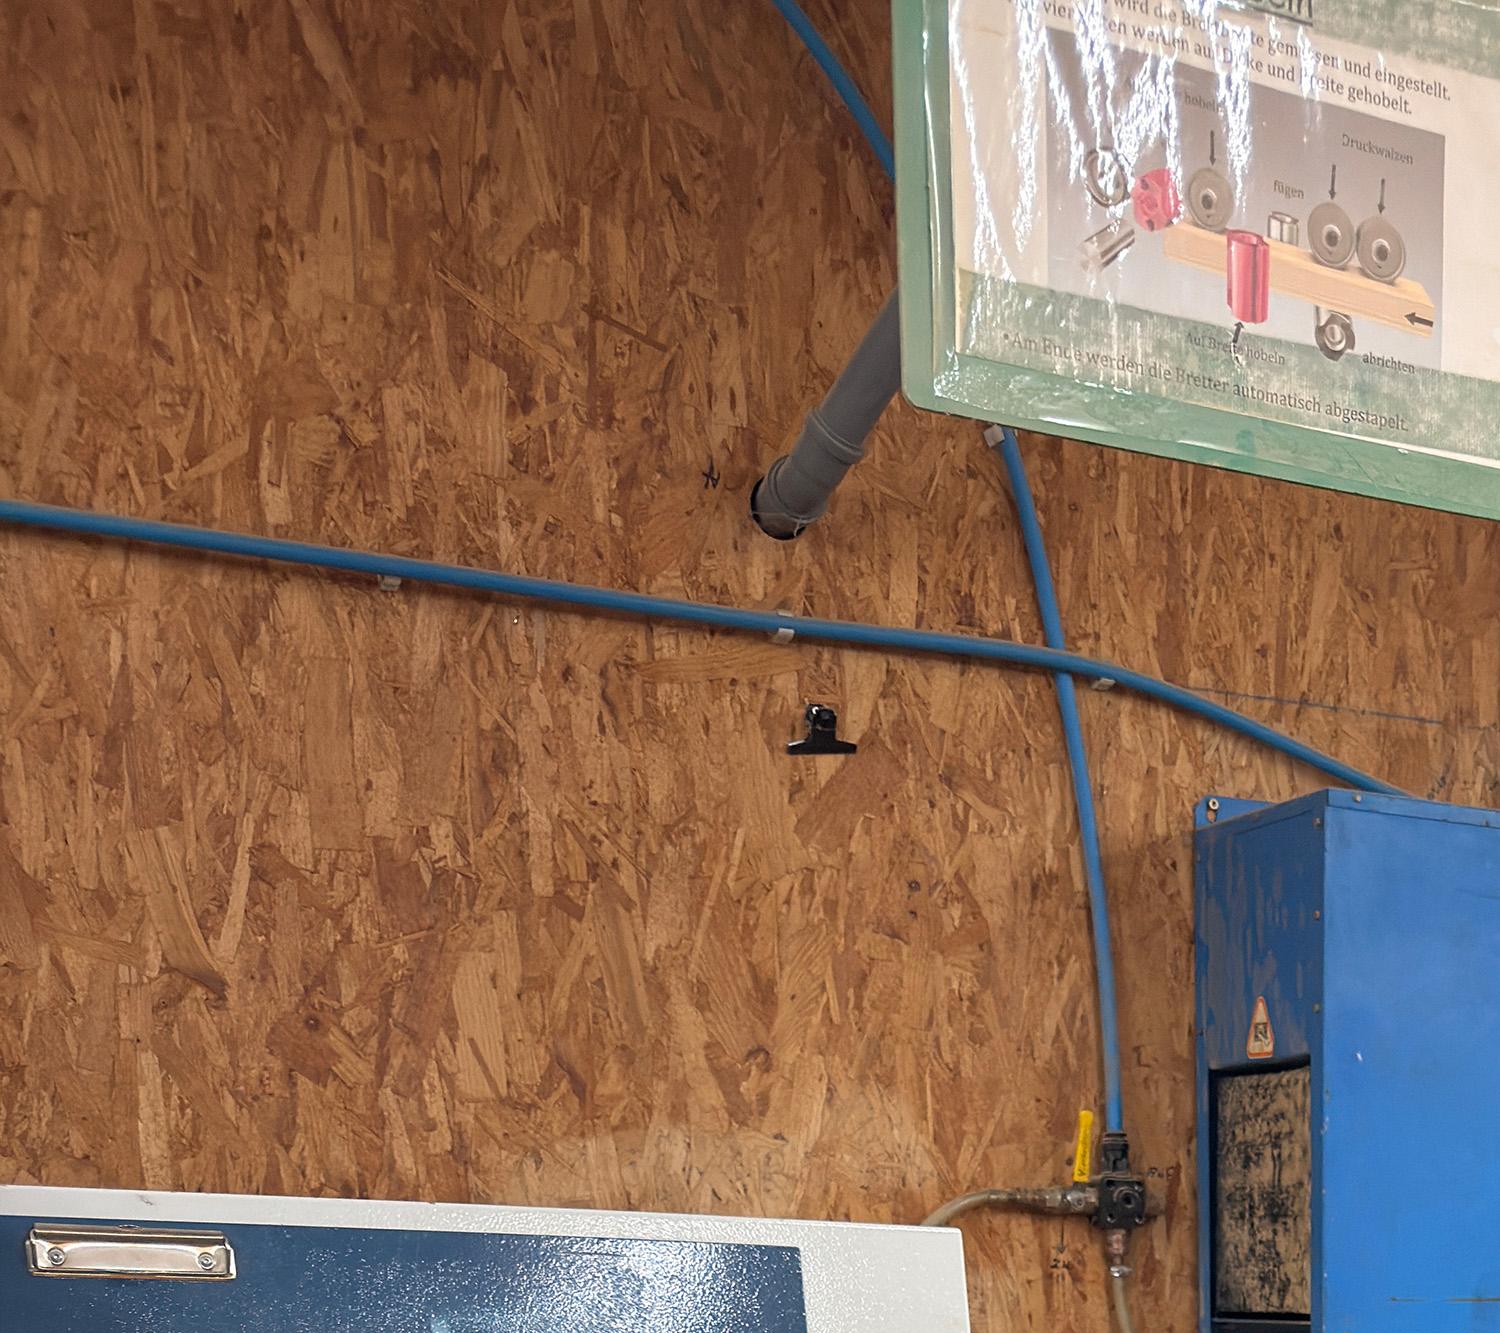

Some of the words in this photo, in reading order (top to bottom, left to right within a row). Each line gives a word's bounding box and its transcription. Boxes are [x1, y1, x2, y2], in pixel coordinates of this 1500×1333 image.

[1154, 4, 1177, 23] die
[1267, 37, 1340, 71] gemsen
[1343, 59, 1371, 80] und
[1375, 67, 1451, 101] eingestellt.
[1194, 41, 1221, 61] au
[1222, 45, 1264, 72] Dke
[1267, 63, 1295, 82] und
[1347, 84, 1413, 115] gehobelt.
[1341, 132, 1414, 166] Druckwalzen
[1273, 179, 1305, 200] fügen
[1246, 345, 1286, 365] hobeln
[1362, 352, 1415, 374] abrichten
[1012, 332, 1037, 350] Am
[1086, 350, 1145, 376] werden
[1148, 362, 1172, 381] die
[1175, 367, 1229, 393] Bretter
[1232, 382, 1321, 413] automatisch
[1325, 401, 1409, 432] abgestapelt.
